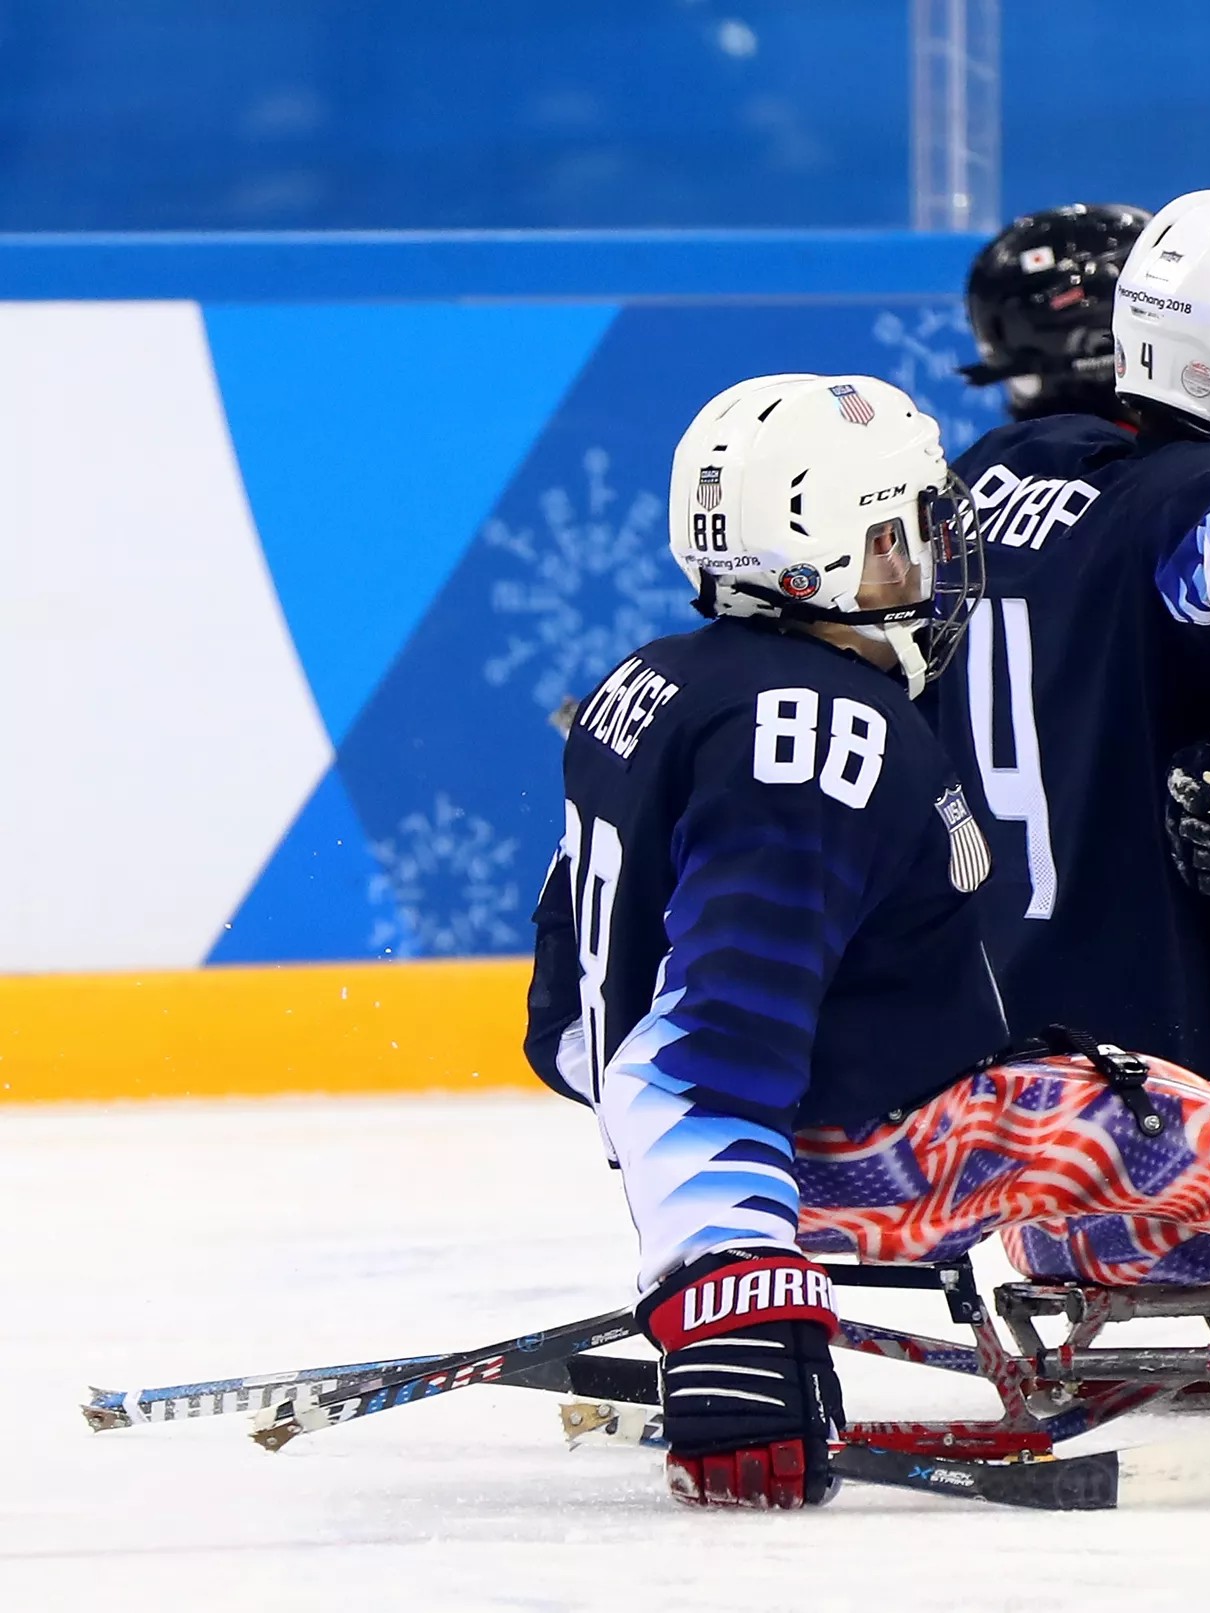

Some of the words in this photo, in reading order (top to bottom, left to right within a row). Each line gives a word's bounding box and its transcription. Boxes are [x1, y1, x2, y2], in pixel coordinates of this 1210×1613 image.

[1166, 299, 1192, 314] 2018
[1141, 342, 1152, 380] 4
[859, 483, 907, 506] CCM
[693, 513, 727, 551] 88
[884, 610, 916, 620] CCM
[753, 687, 888, 809] 88
[965, 598, 1057, 919] 4
[944, 798, 968, 825] USA
[930, 1474, 974, 1487] STRIKE
[934, 1469, 972, 1481] QUICK
